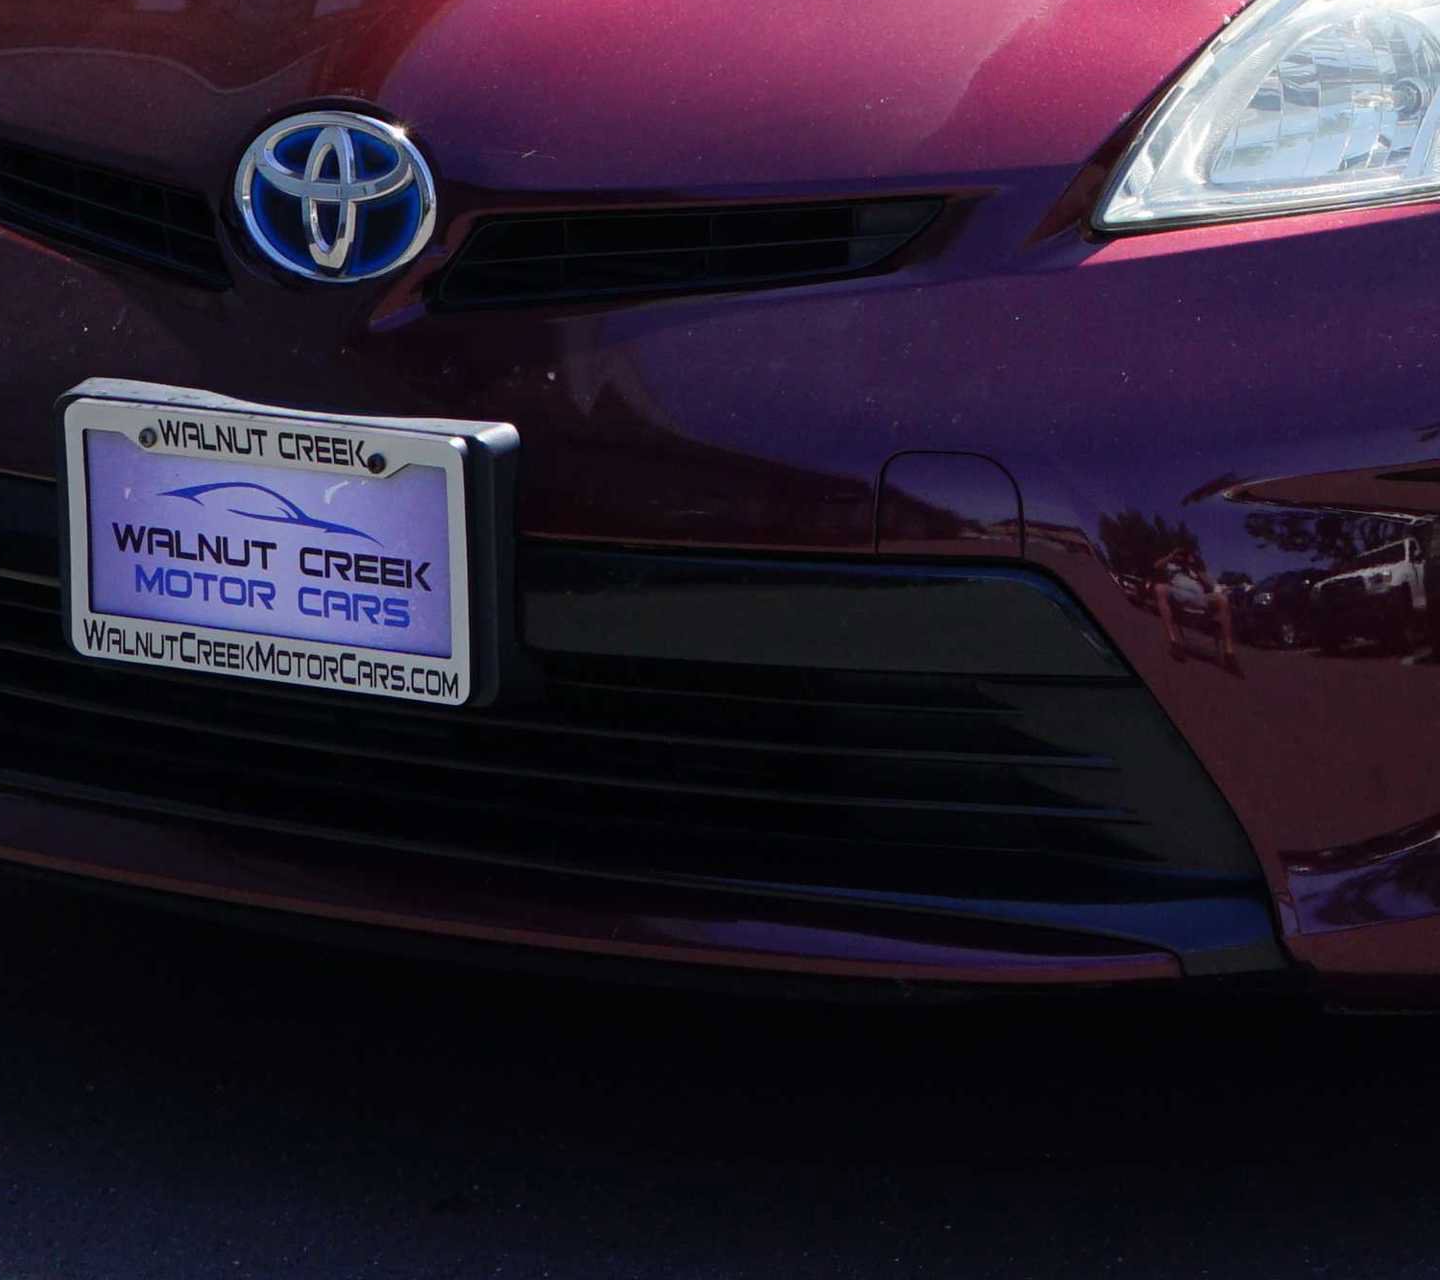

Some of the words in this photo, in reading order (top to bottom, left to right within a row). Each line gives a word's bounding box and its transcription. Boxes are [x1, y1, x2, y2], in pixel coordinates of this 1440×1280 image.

[158, 418, 267, 457] WALNUT
[278, 432, 368, 469] CREEK
[112, 522, 277, 570] WALNUT
[299, 547, 432, 592] CREEK
[135, 564, 275, 611] MOTOR
[297, 586, 410, 628] CARS
